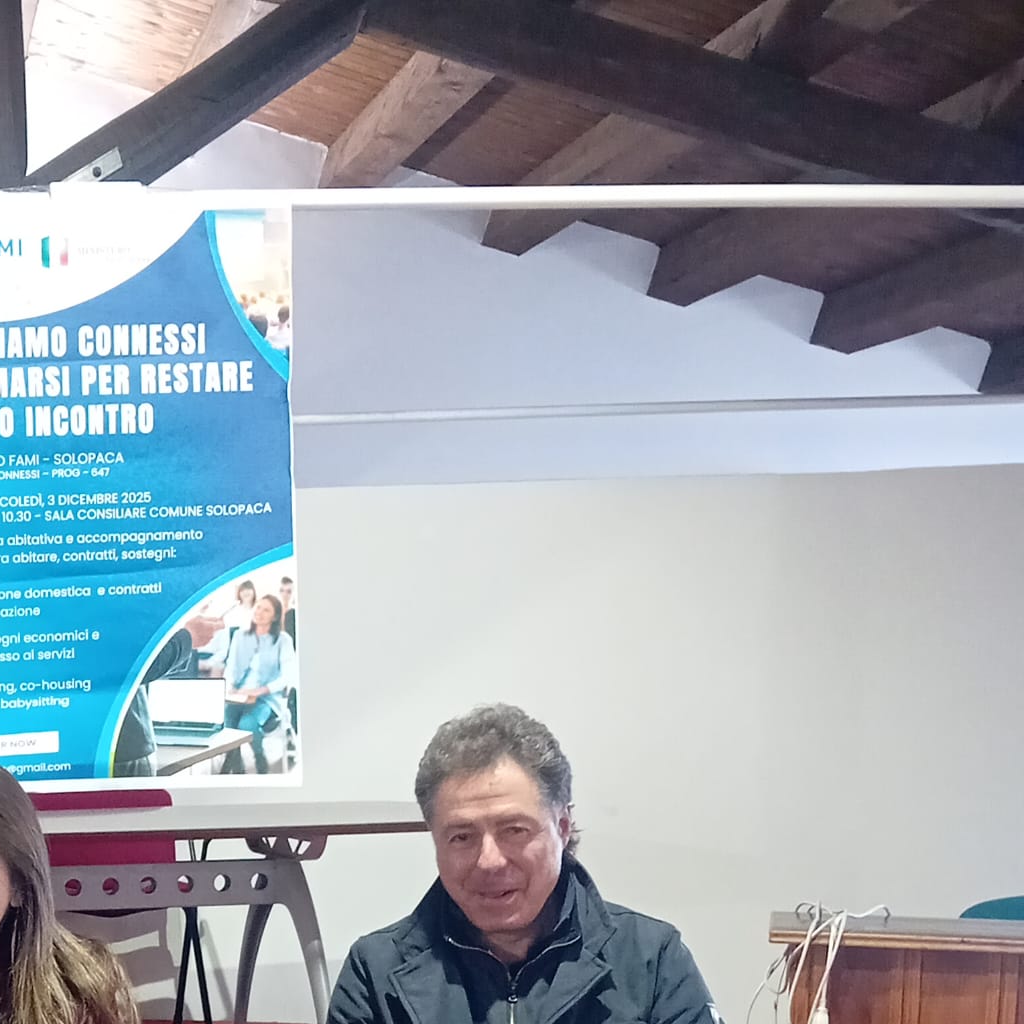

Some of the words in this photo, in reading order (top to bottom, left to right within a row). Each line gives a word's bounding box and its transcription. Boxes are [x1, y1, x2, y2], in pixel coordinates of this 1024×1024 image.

[79, 323, 205, 356] CONNESSI
[82, 364, 130, 395] PER
[141, 361, 253, 393] RESTARE
[26, 403, 154, 437] INCONTRO
[9, 454, 39, 466] FAMI
[53, 452, 124, 465] SOLOPACA
[52, 469, 80, 478] PROG
[91, 468, 109, 477] 647
[48, 495, 55, 505] 3
[58, 493, 118, 506] DICEMBRE
[120, 492, 151, 503] 2025
[1, 510, 31, 522] 10.30
[44, 509, 74, 520] SALA
[77, 506, 147, 520] CONSILIARE
[149, 504, 203, 517] COMUNE
[206, 502, 271, 516] SOLOPACA
[7, 533, 63, 546] abitativa
[66, 535, 74, 543] e
[77, 529, 203, 547] accompagnamento
[12, 549, 60, 564] abitare,
[63, 548, 118, 563] contratti,
[121, 546, 176, 562] sostegni:
[24, 584, 91, 600] domestica
[97, 586, 106, 595] e
[109, 582, 162, 595] contratti
[23, 629, 88, 644] economici
[92, 631, 99, 641] e
[22, 648, 34, 660] ai
[38, 646, 75, 660] servizi
[20, 677, 91, 693] co-housing
